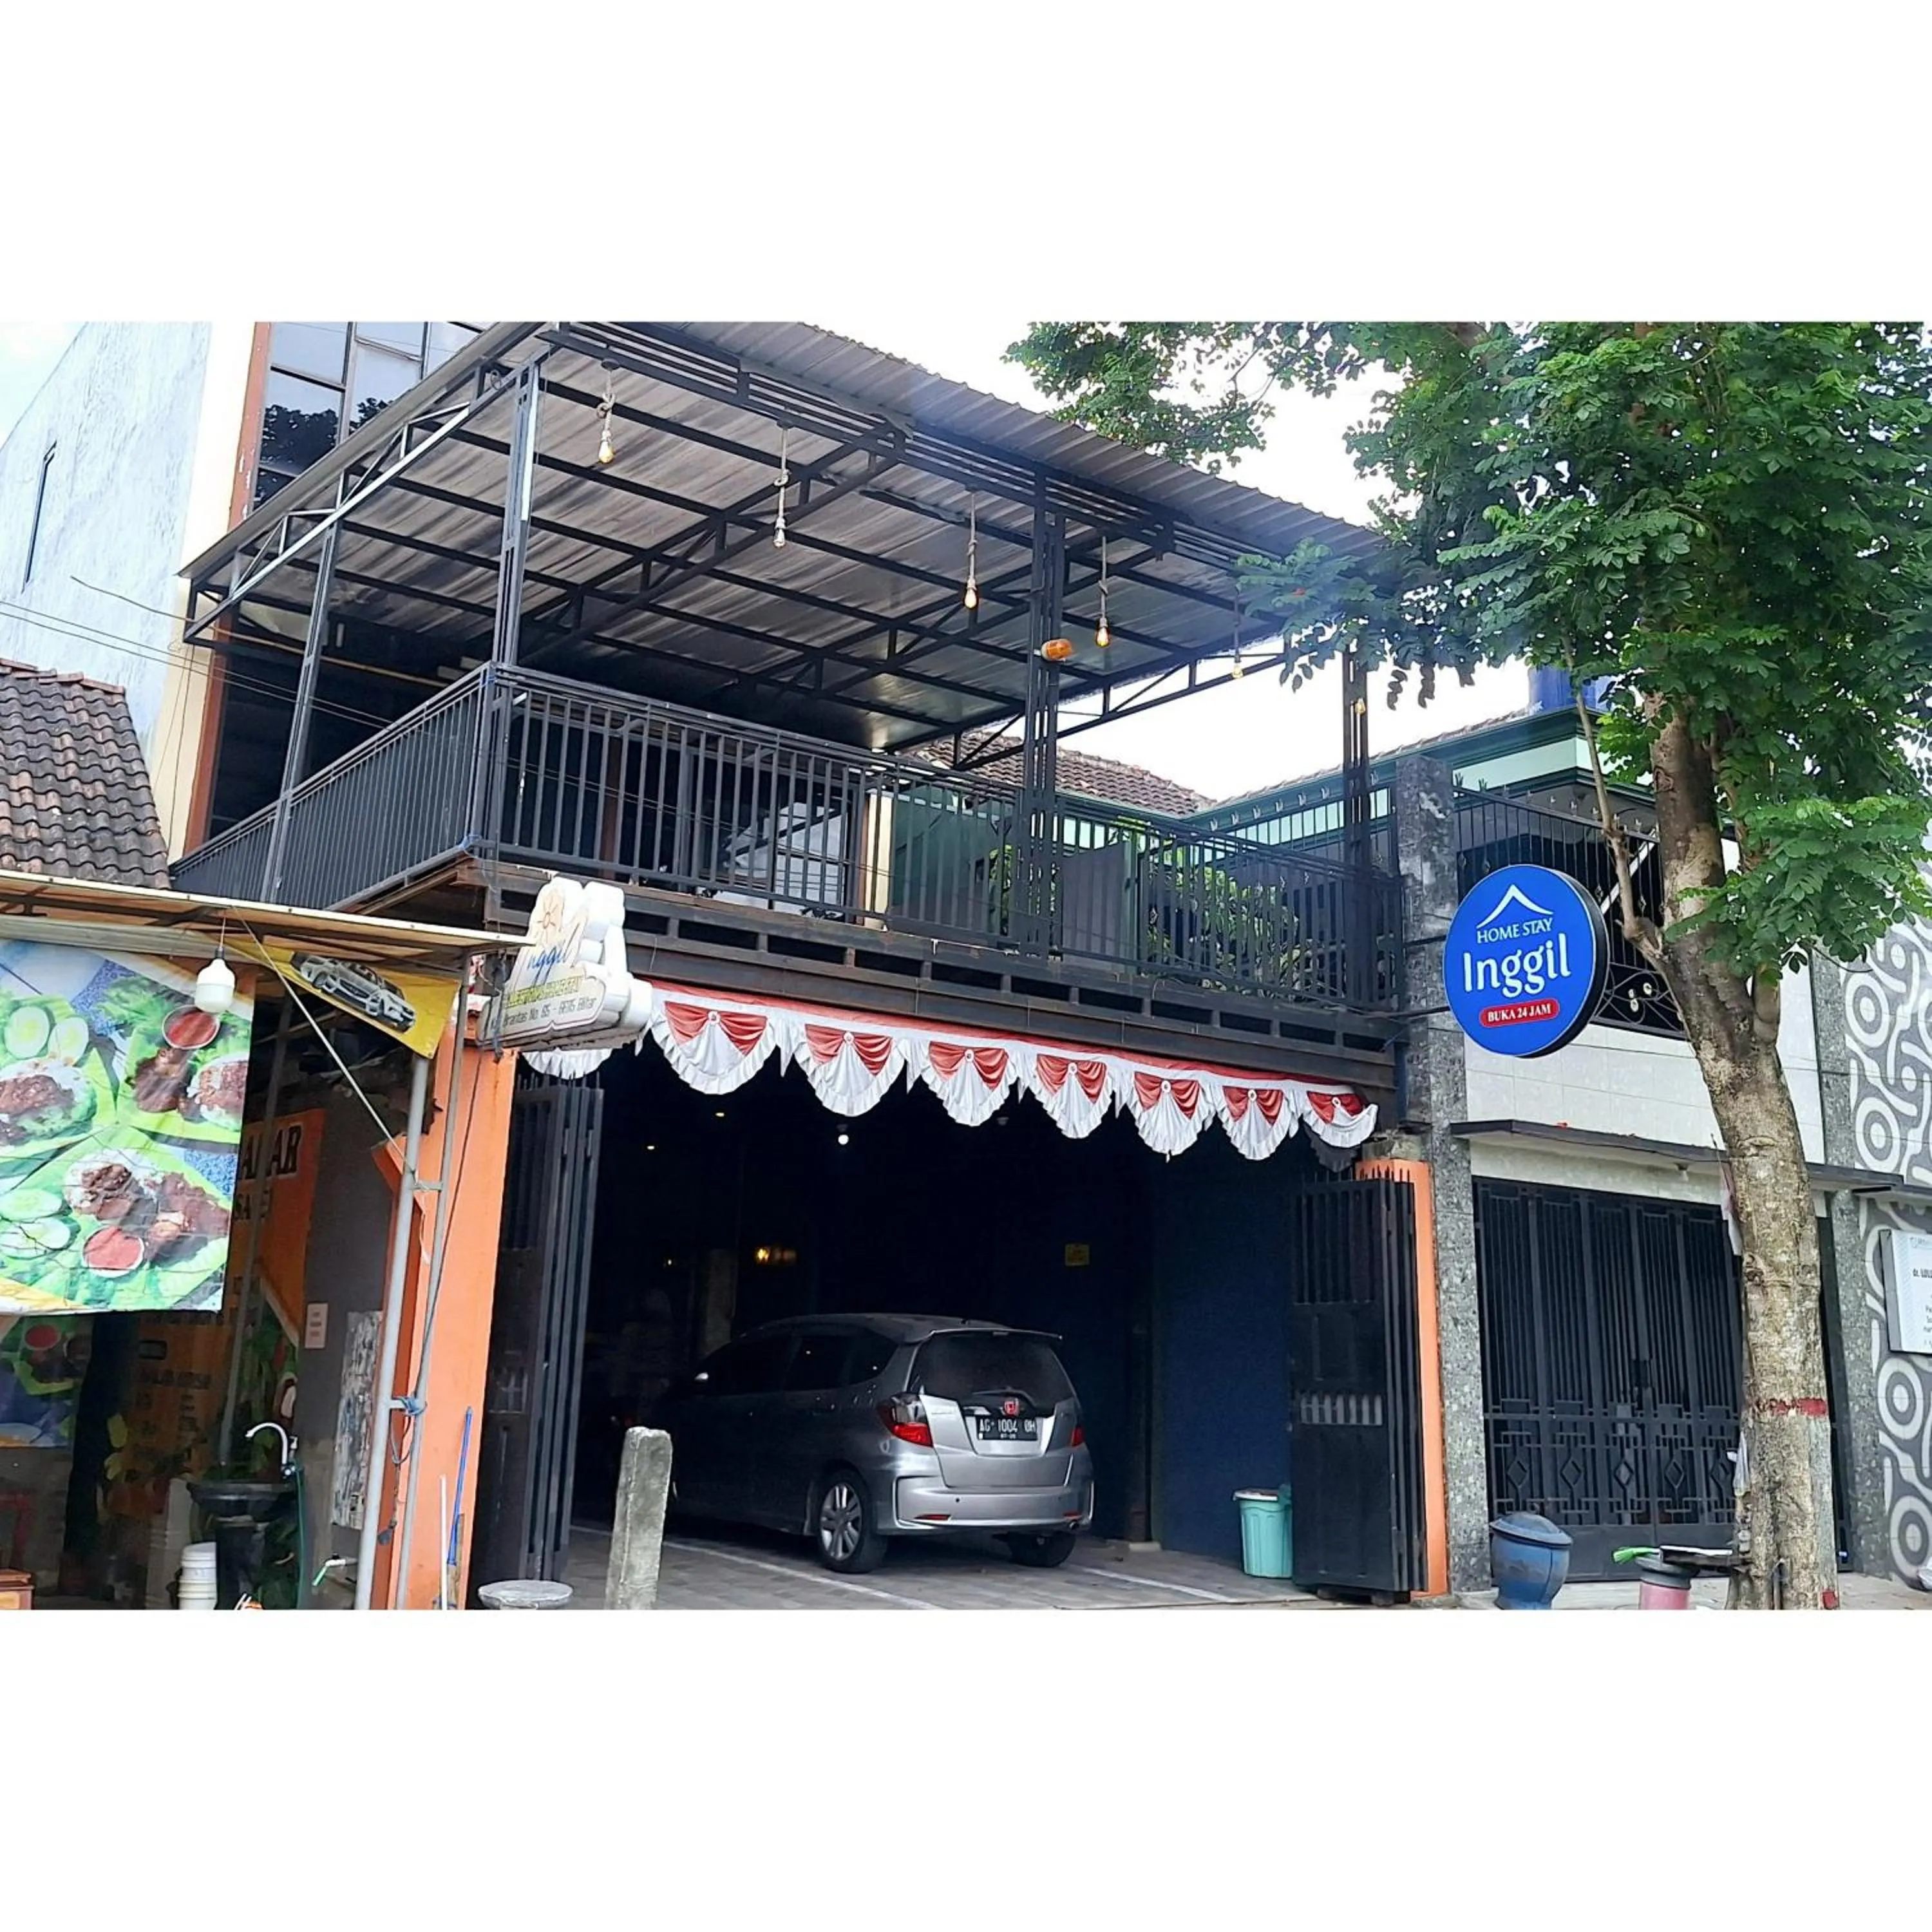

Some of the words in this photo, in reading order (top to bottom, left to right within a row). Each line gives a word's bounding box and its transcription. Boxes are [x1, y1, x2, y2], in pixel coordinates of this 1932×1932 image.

[1477, 923, 1520, 944] HOME
[1522, 917, 1553, 936] STAY
[1463, 933, 1571, 998] Inggil
[1488, 1008, 1516, 1023] BUKA
[1517, 1007, 1528, 1019] 24
[1529, 1003, 1551, 1016] JAM
[979, 1418, 991, 1432] AG
[998, 1418, 1018, 1433] 1004
